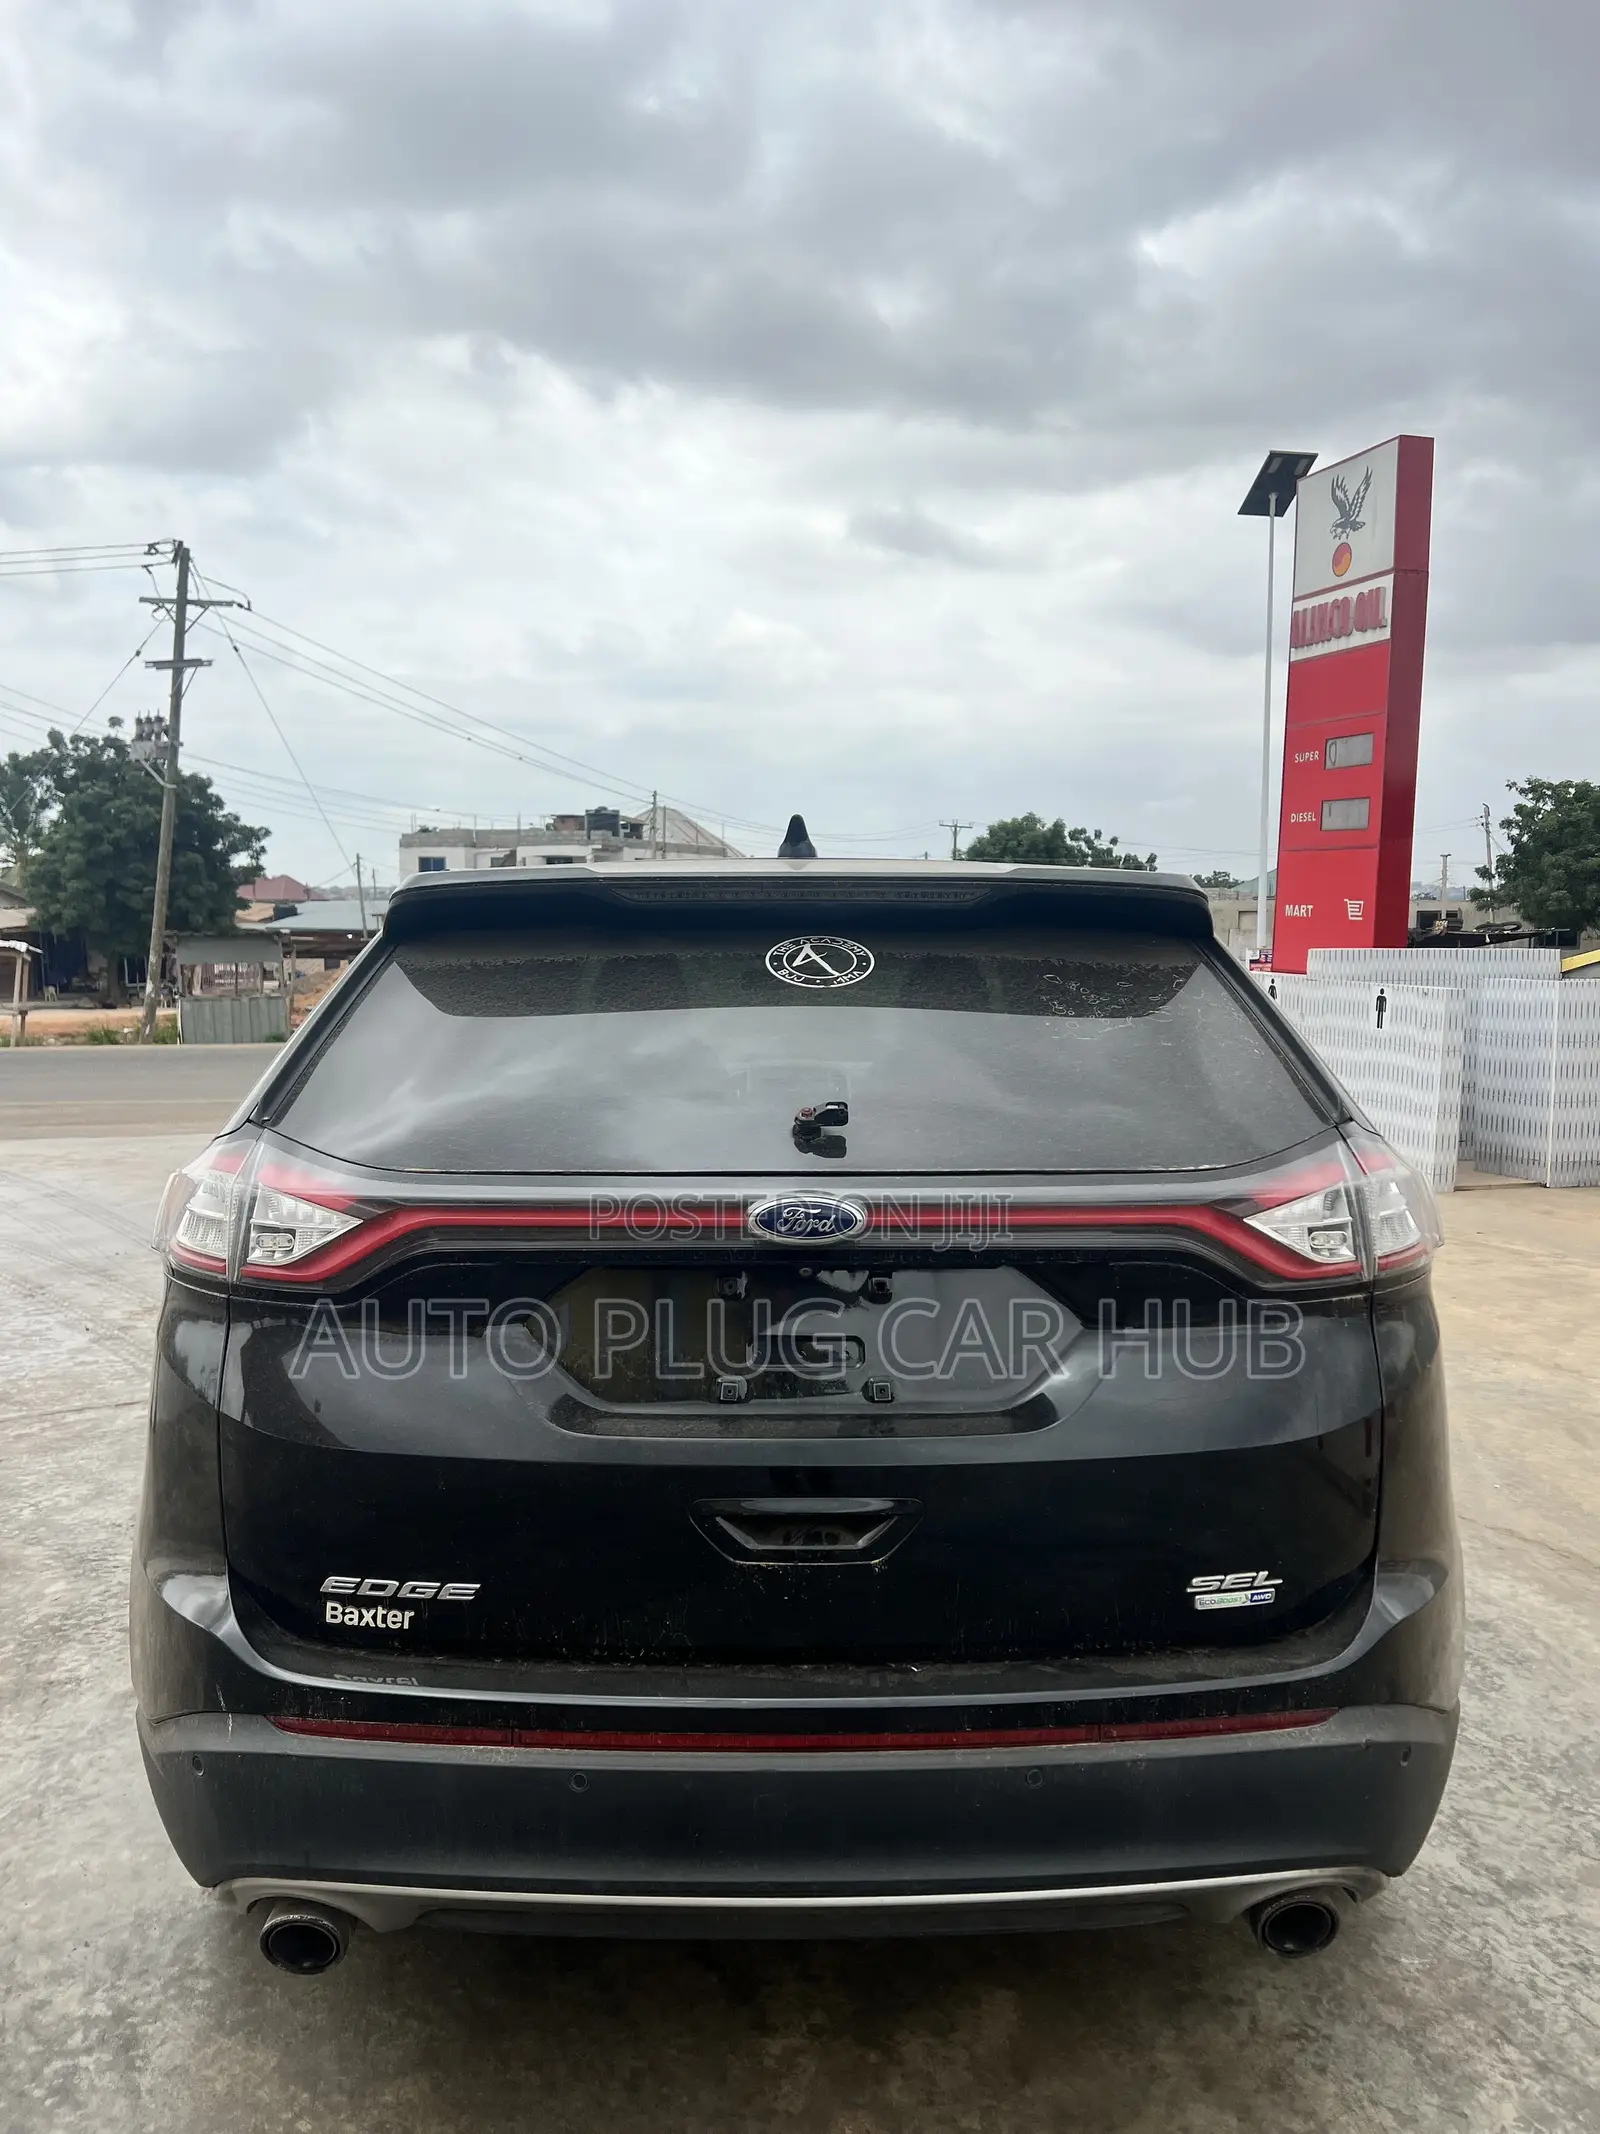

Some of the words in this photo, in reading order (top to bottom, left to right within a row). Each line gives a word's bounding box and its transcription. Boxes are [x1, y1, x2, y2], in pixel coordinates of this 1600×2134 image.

[1294, 750, 1319, 763] SUPER
[1290, 811, 1317, 824] DIESEL
[1285, 904, 1314, 918] MART
[772, 942, 797, 956] THE
[800, 937, 867, 957] ACADEMY
[777, 968, 806, 982] BJJ
[776, 1206, 837, 1233] Ford
[319, 1575, 481, 1600] EDGE
[1186, 1571, 1283, 1592] SEL
[1251, 1592, 1273, 1602] AWD
[324, 1601, 415, 1630] Baxter
